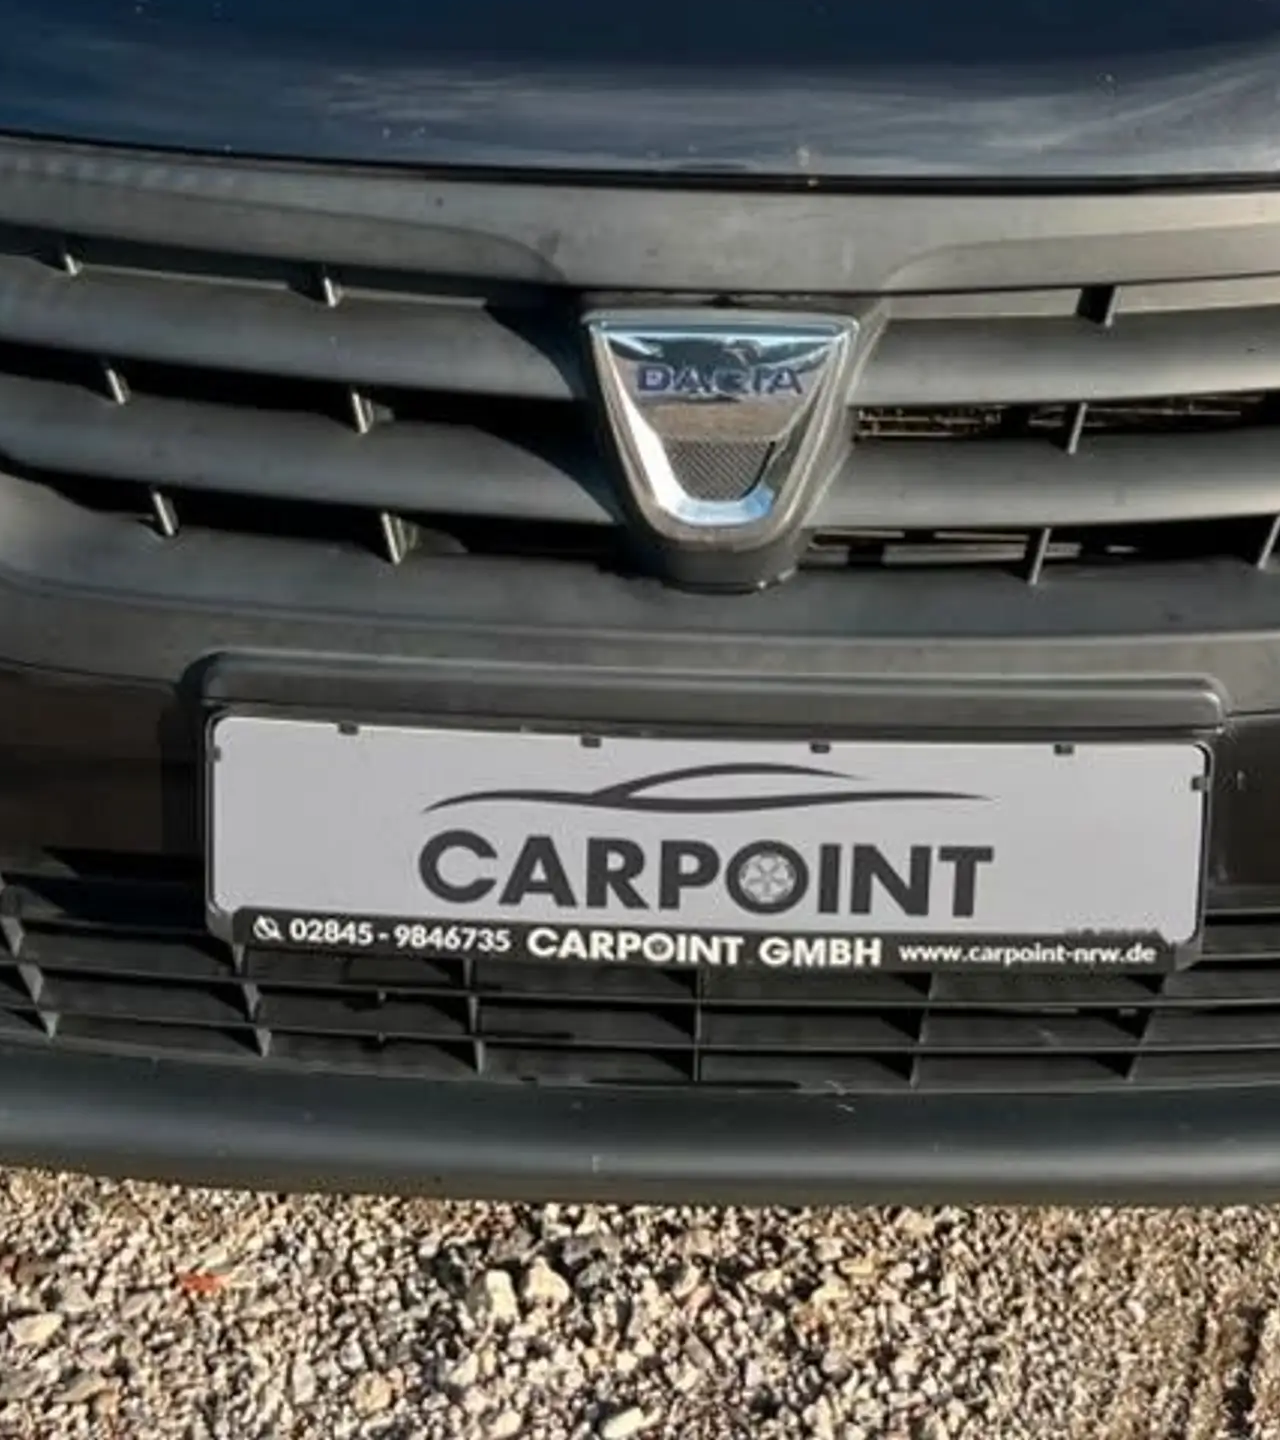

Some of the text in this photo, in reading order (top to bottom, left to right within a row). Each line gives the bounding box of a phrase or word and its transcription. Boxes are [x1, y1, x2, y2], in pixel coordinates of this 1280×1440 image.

[637, 364, 803, 396] DACIA
[418, 828, 996, 919] CARPOINT
[288, 917, 374, 946] 02845
[393, 923, 512, 954] 9846735
[525, 926, 745, 968] CARPOINT
[757, 935, 883, 969] GMBH
[897, 941, 1158, 969] www.carpoint-nrw.de
